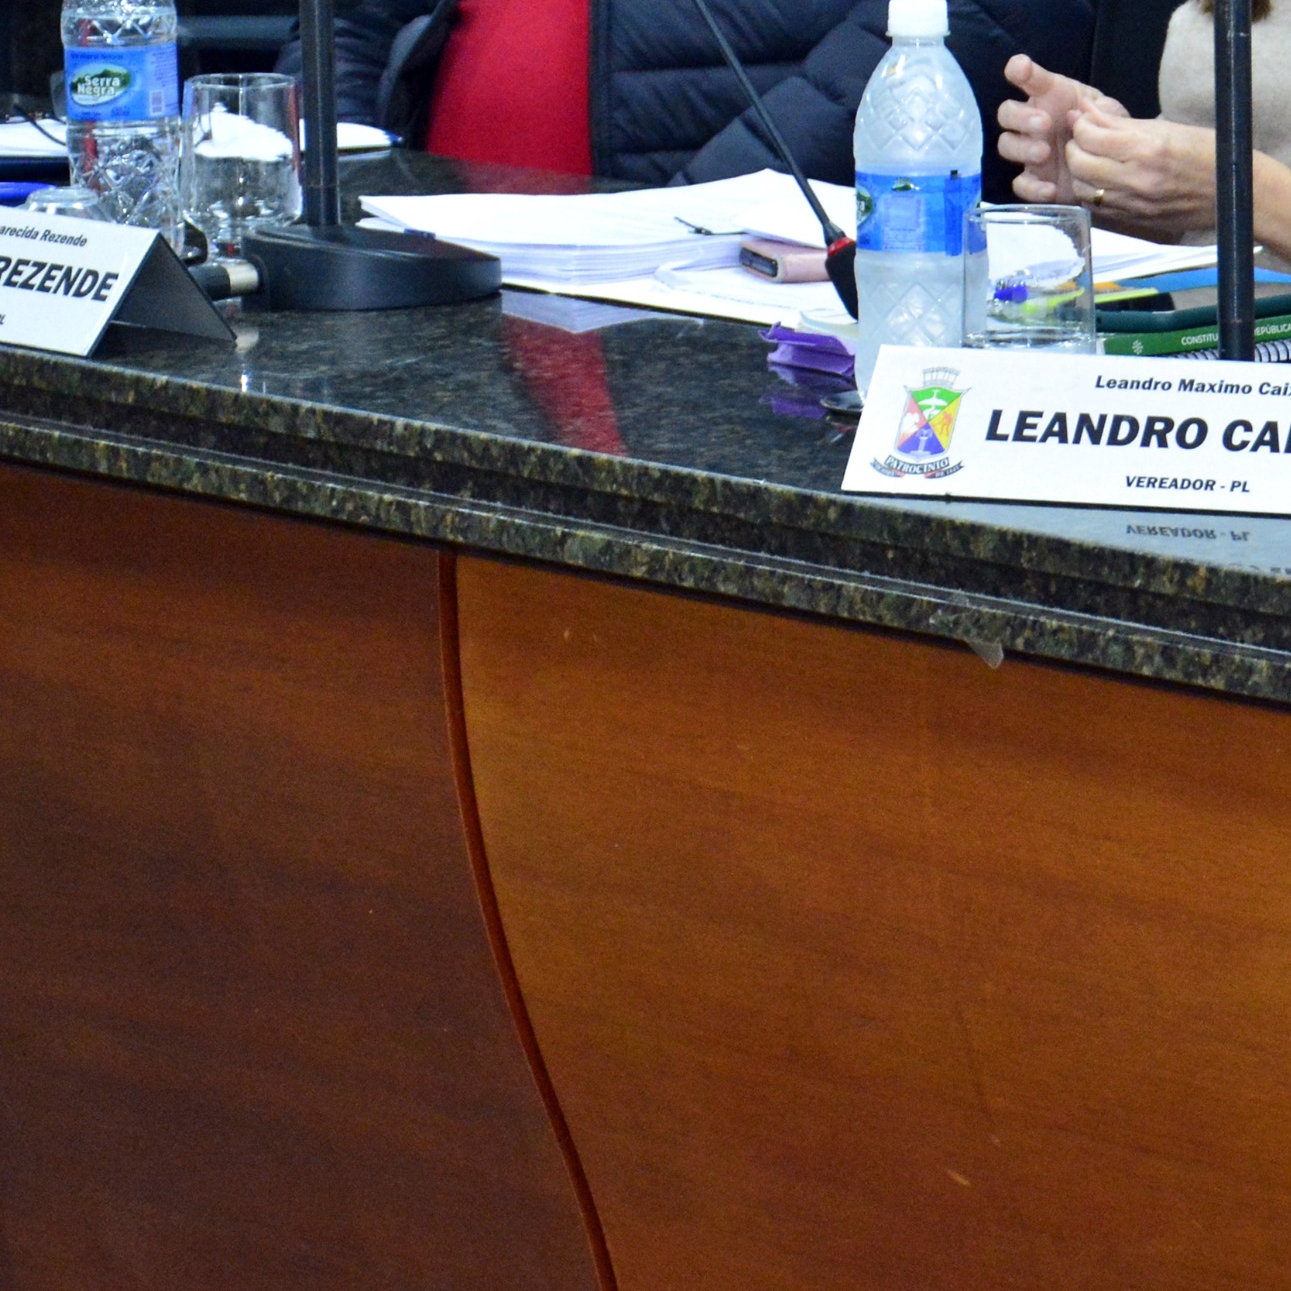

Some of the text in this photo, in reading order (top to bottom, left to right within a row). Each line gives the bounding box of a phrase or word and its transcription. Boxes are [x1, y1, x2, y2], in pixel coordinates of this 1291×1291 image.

[77, 83, 115, 97] Negra
[85, 74, 120, 87] Serra
[0, 225, 88, 247] arecida Rezende
[0, 255, 119, 302] REZENDE
[1181, 332, 1219, 347] CONSTITU
[1095, 375, 1172, 392] Leandro
[1177, 379, 1253, 395] Maximo
[985, 409, 1208, 450] LEANDRO
[1125, 475, 1217, 492] VEREADOR
[1230, 480, 1251, 493] PL
